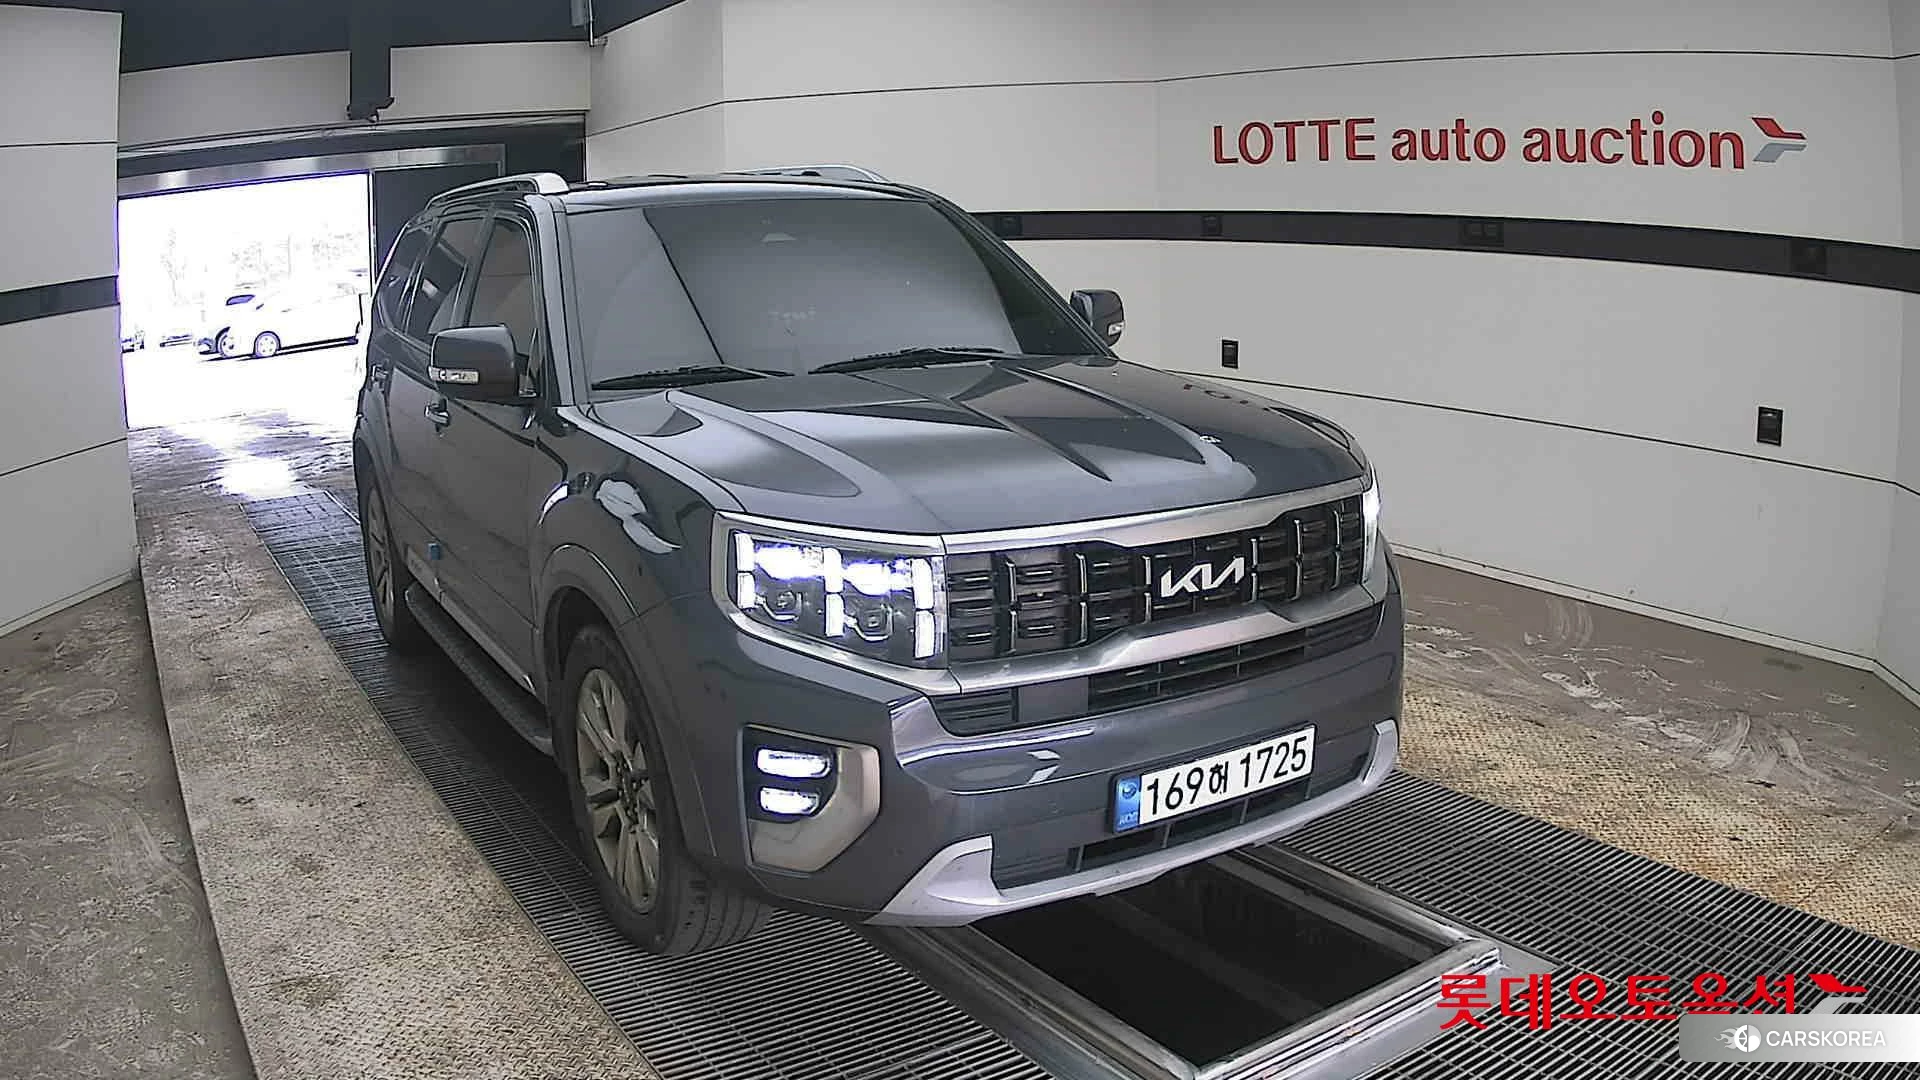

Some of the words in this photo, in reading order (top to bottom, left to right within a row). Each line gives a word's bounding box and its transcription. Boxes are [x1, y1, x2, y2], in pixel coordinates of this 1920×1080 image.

[1212, 118, 1376, 165] LOTTE
[1391, 118, 1507, 162] auto
[1521, 110, 1746, 170] auction
[1160, 556, 1245, 598] KIA
[1146, 760, 1230, 816] 169허
[1239, 735, 1308, 789] 1725
